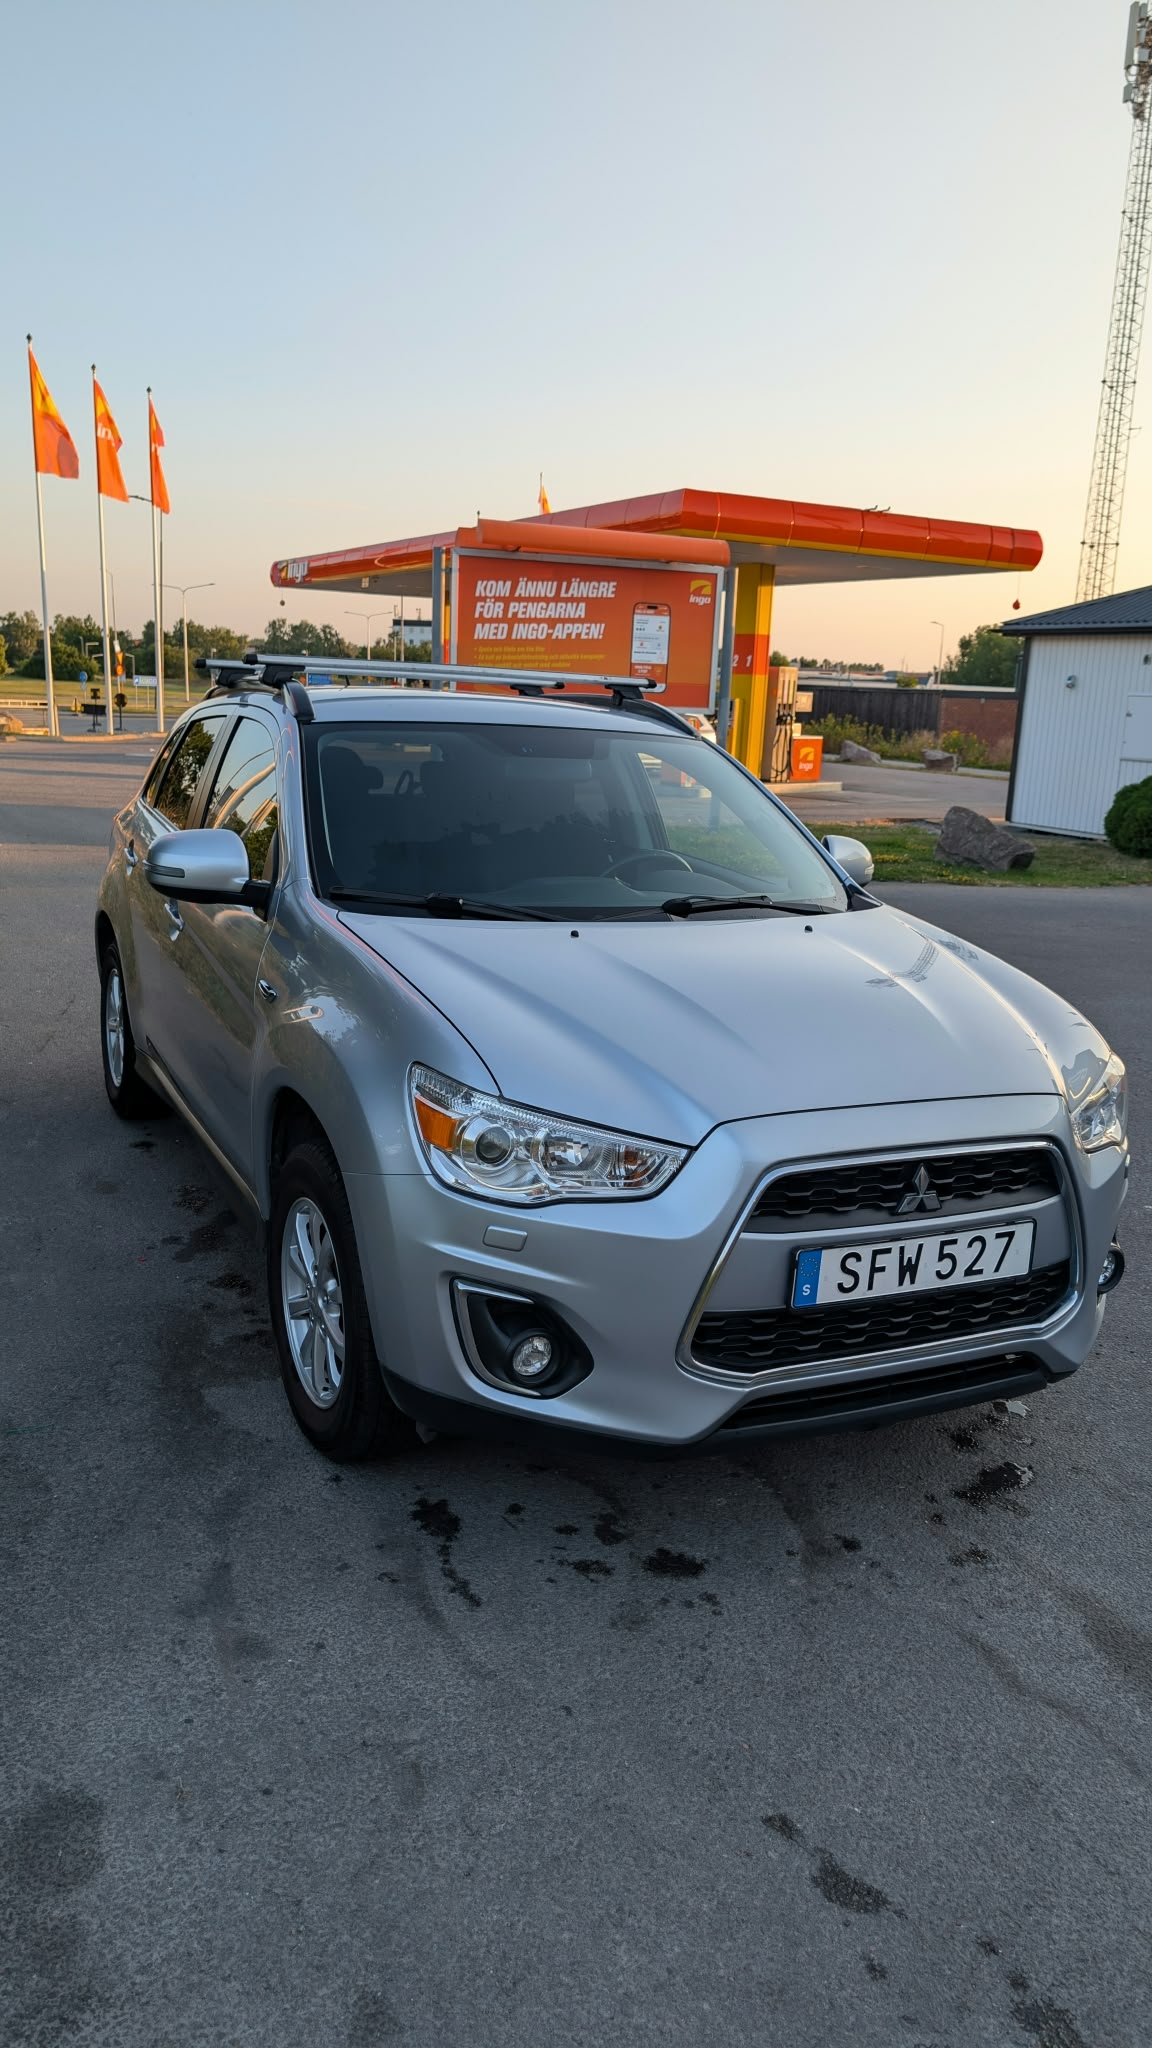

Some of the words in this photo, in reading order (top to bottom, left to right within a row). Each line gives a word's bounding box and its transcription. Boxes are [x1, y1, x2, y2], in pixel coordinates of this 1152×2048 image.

[475, 580, 512, 597] KOM
[514, 577, 557, 598] ÄNNU
[560, 577, 617, 598] LÄNGRE
[474, 598, 504, 619] FÖR
[507, 601, 586, 619] PENGARNA
[689, 594, 711, 606] ingo
[473, 623, 509, 640] MED
[511, 623, 605, 640] INGO-APPEN!
[732, 654, 739, 667] 2
[746, 655, 752, 667] 1
[836, 1242, 925, 1294] SFW
[934, 1230, 1016, 1281] 527
[801, 1284, 811, 1296] S
